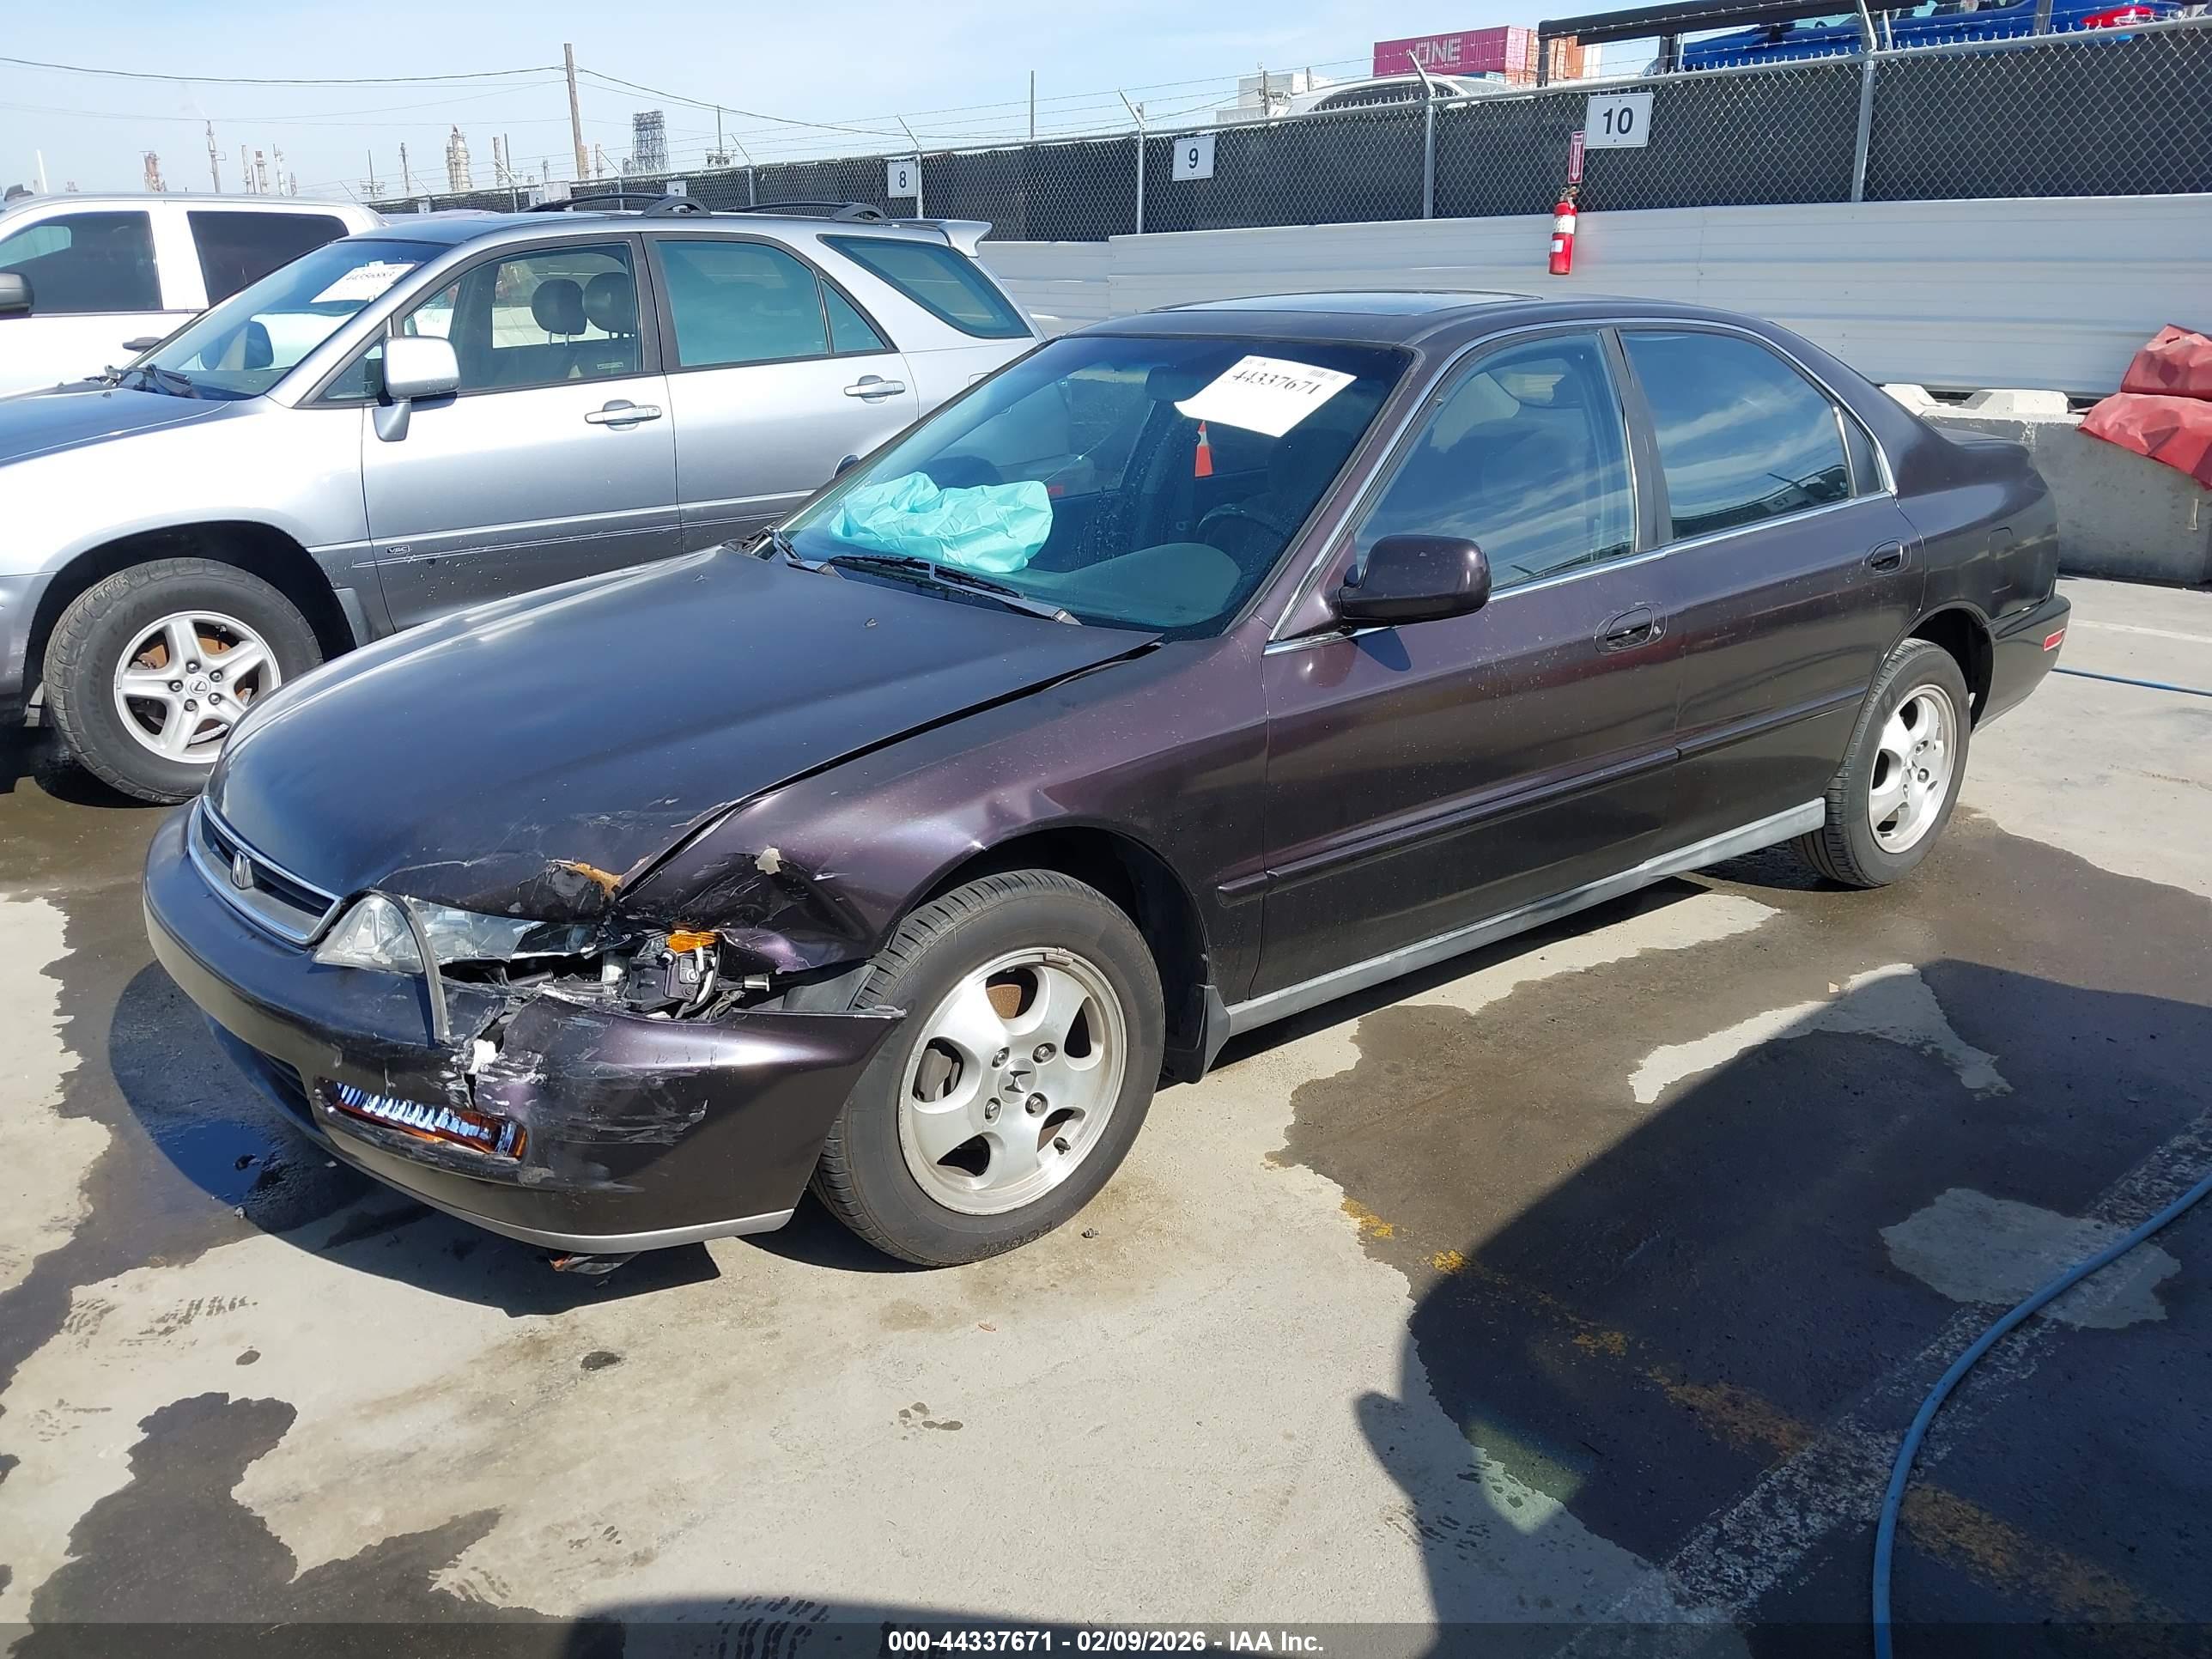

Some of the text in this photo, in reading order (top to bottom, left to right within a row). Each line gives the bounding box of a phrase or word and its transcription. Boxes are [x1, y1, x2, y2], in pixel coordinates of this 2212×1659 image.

[1415, 38, 1461, 64] ONE
[1602, 107, 1633, 135] 10
[1188, 148, 1199, 169] 9
[899, 171, 907, 189] 8
[1232, 370, 1322, 395] 44337671
